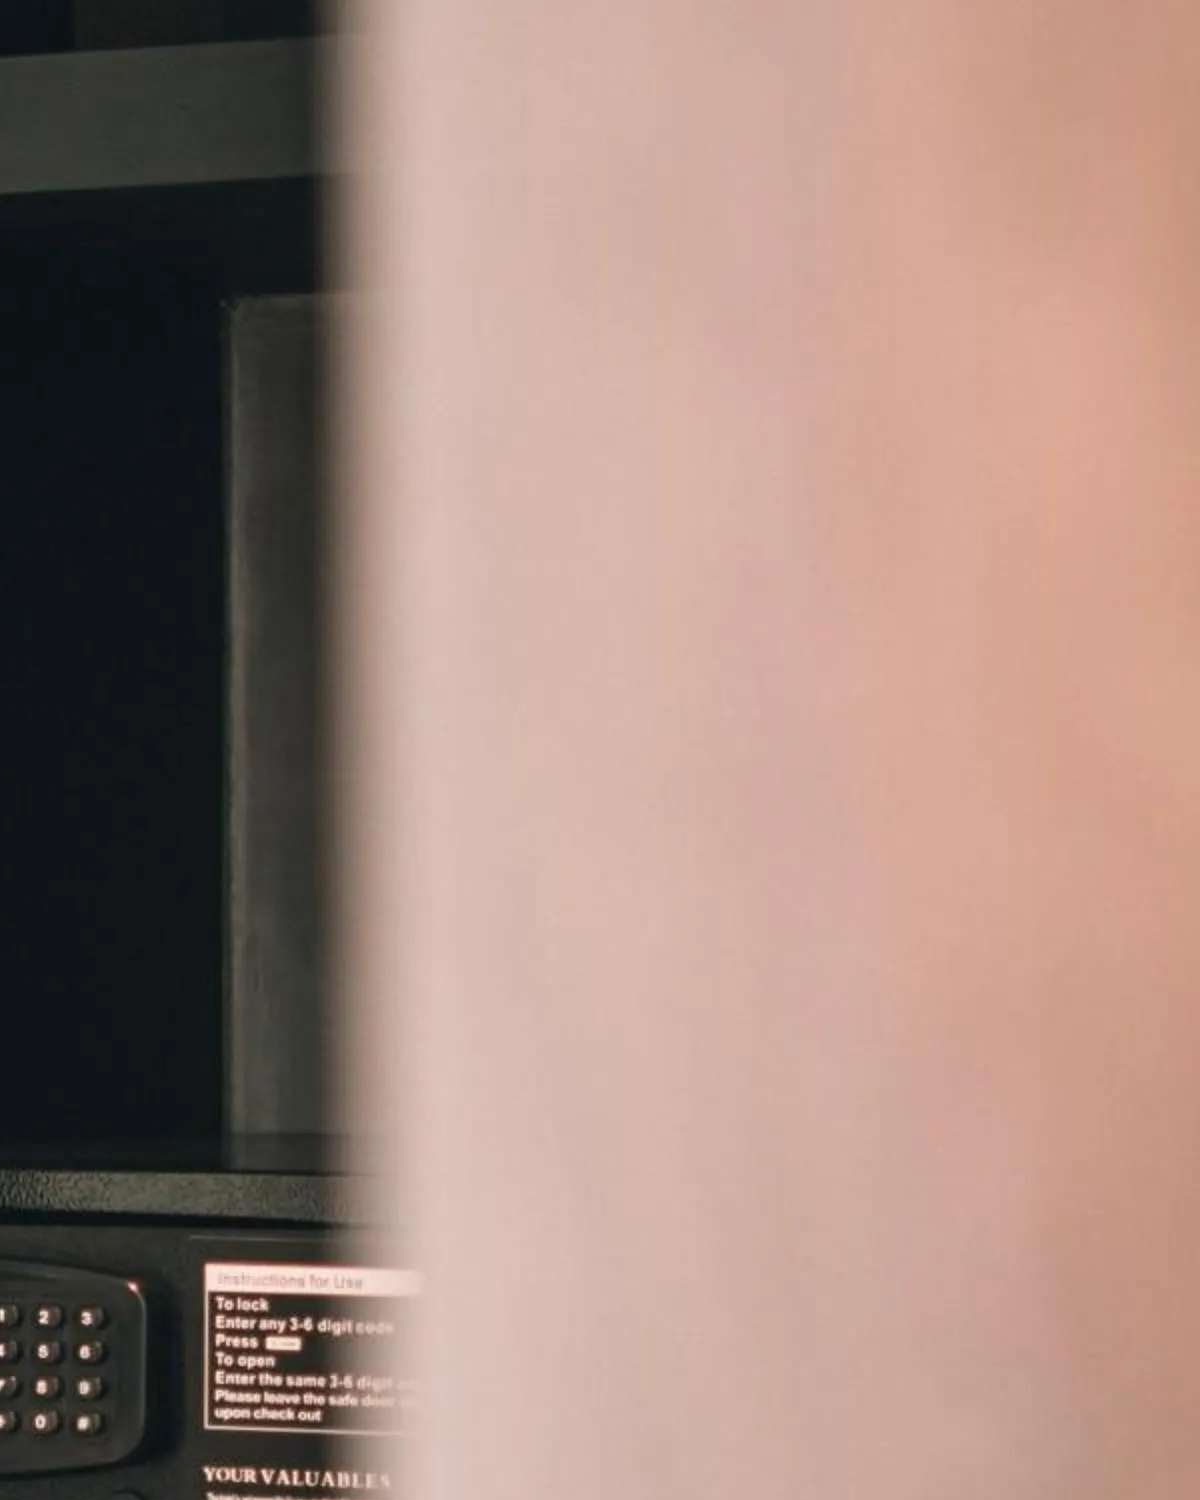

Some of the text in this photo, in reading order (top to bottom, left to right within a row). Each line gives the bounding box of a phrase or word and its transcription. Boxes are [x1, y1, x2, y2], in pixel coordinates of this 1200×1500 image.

[217, 1272, 305, 1289] Instructions
[309, 1273, 329, 1289] for
[215, 1296, 269, 1312] To lock
[38, 1309, 49, 1324] 2
[81, 1311, 92, 1326] 3
[215, 1315, 256, 1330] Enter
[259, 1318, 286, 1334] any
[289, 1317, 313, 1331] 3-6
[317, 1318, 353, 1336] digit
[215, 1334, 258, 1348] Press
[215, 1352, 275, 1370] To open
[215, 1371, 256, 1385] Enter
[259, 1372, 282, 1387] the
[285, 1374, 326, 1387] same
[215, 1390, 260, 1403] Please
[303, 1392, 325, 1405] the
[35, 1414, 46, 1429] 0
[214, 1407, 322, 1423] upon check out
[203, 1467, 257, 1484] YOUR
